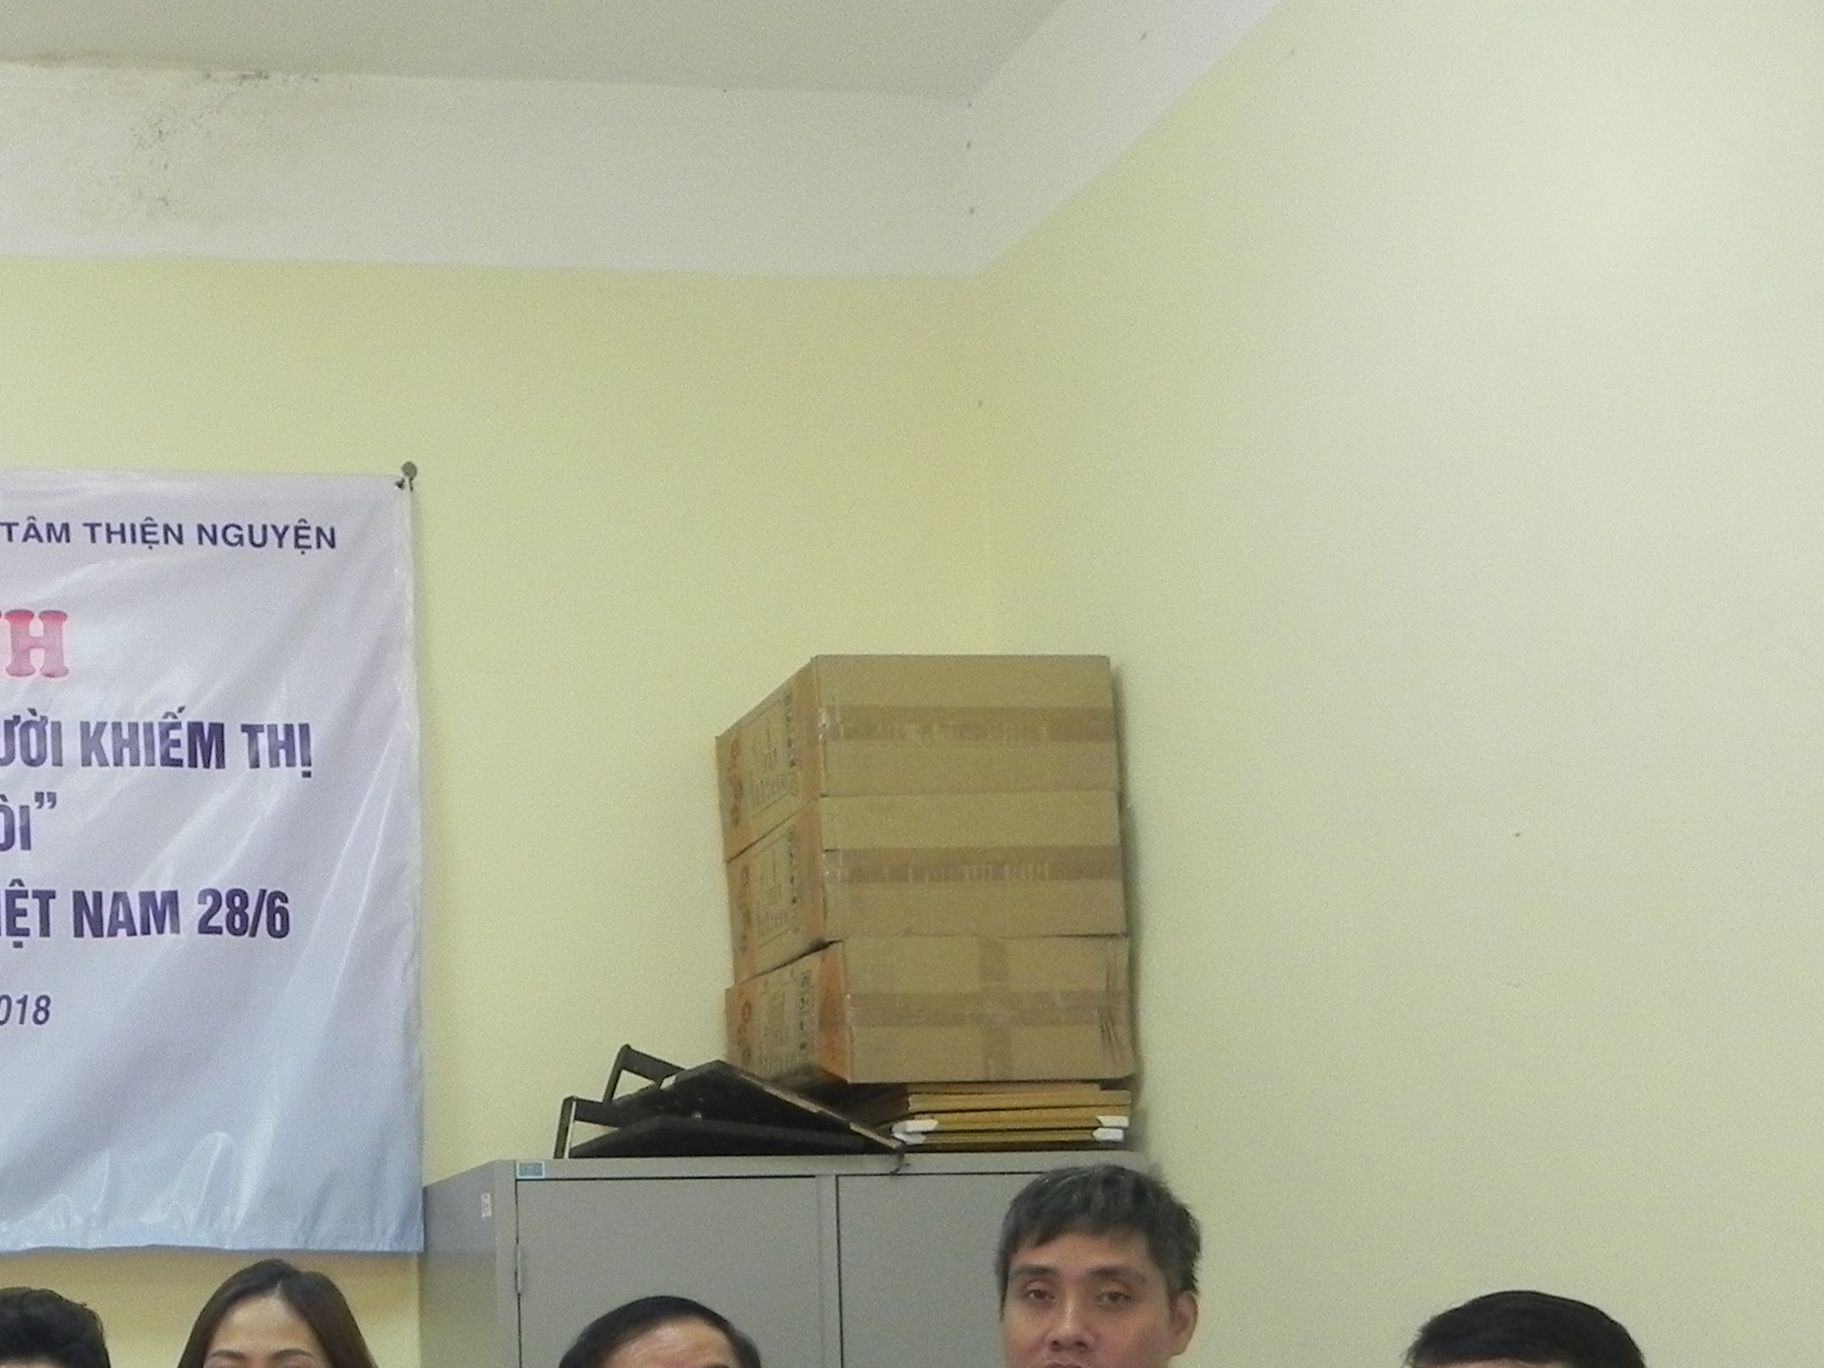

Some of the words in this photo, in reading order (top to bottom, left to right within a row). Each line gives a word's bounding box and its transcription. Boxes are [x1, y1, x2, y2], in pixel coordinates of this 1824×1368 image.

[0, 515, 72, 544] TÂM
[82, 516, 185, 550] THIỆN
[196, 518, 337, 556] NGUYỆN
[80, 706, 227, 771] KHIẾM
[240, 721, 313, 779] THỊ
[72, 888, 181, 938] NAM
[196, 887, 291, 940] 28/6
